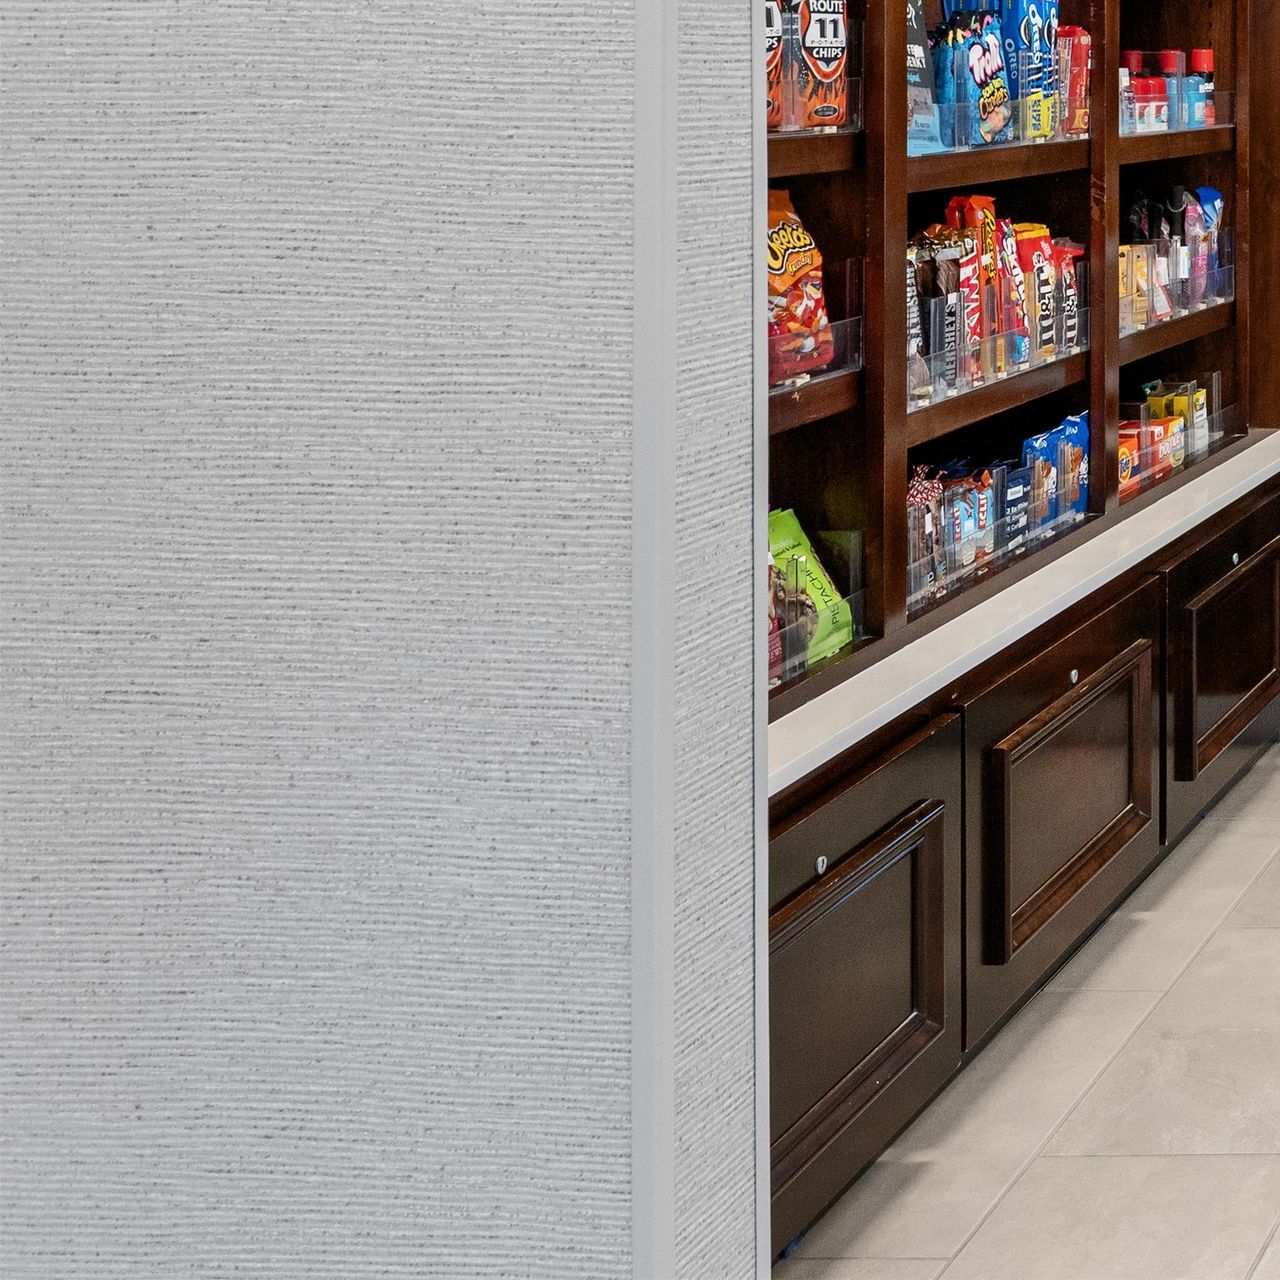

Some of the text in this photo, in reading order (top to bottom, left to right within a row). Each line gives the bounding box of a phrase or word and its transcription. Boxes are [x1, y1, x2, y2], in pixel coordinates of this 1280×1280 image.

[809, 0, 844, 12] ROUTE
[815, 17, 840, 39] 11
[1028, 3, 1043, 65] OREO
[813, 48, 842, 58] CHIPS
[1005, 38, 1019, 80] OREO
[982, 208, 997, 279] Reese's
